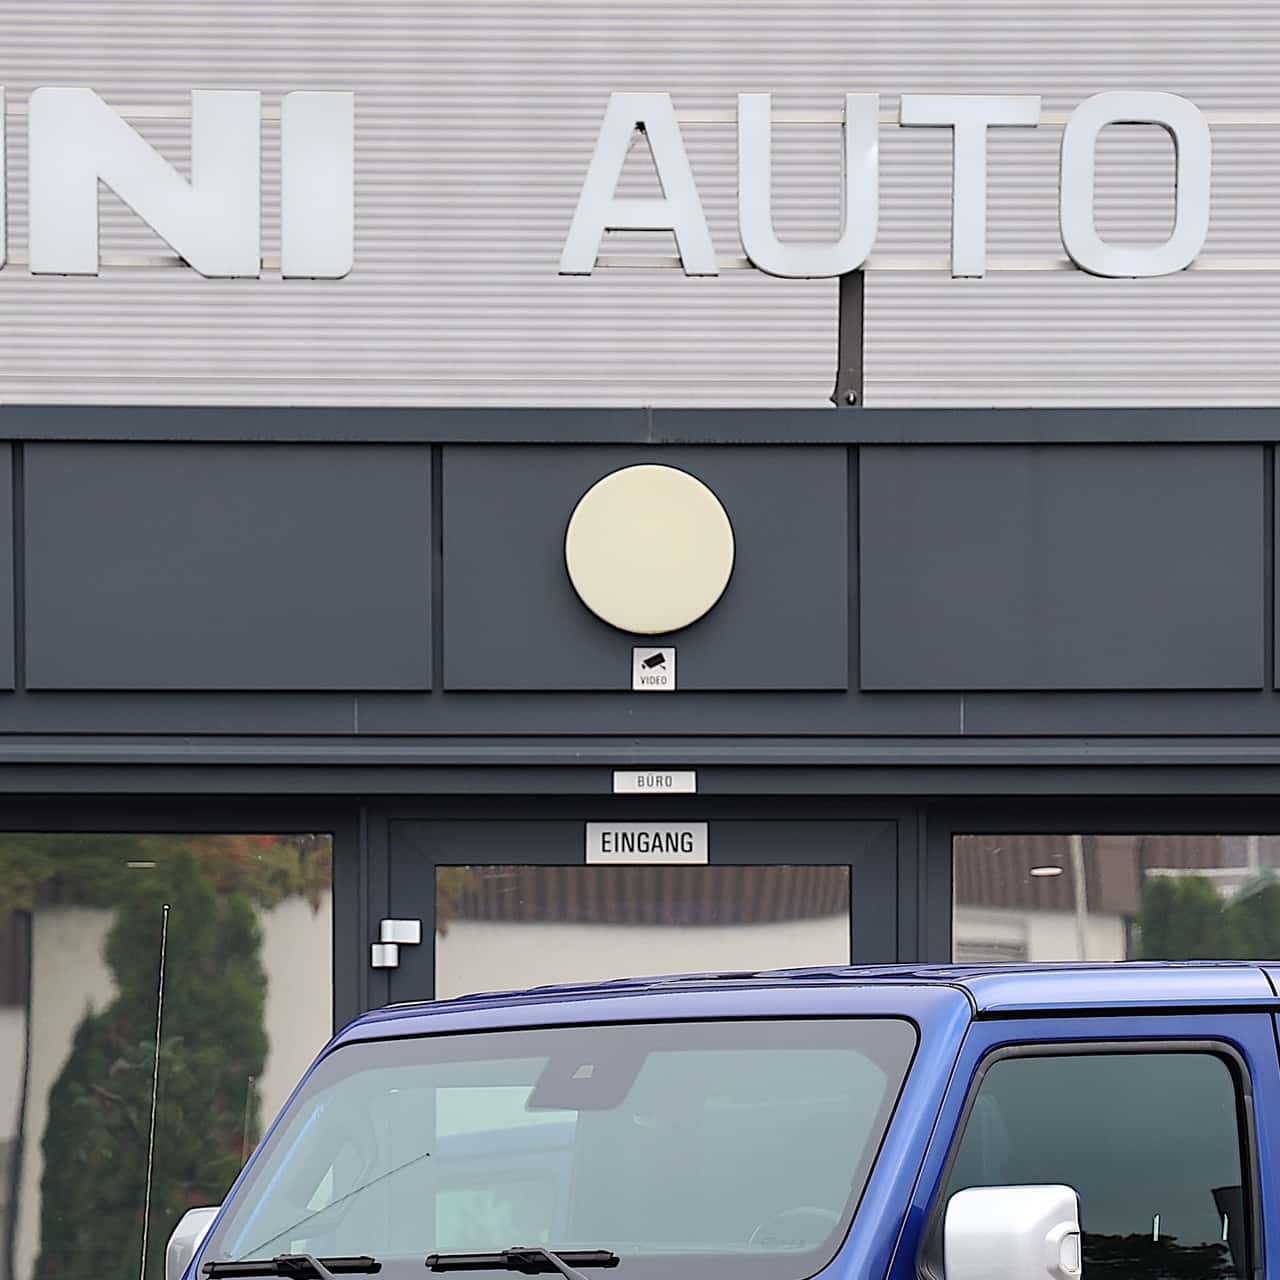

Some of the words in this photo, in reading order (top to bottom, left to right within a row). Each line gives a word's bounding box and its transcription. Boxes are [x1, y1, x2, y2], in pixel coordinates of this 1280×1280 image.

[558, 88, 1211, 278] AUTO
[639, 675, 668, 685] VIDEO
[637, 773, 673, 788] BÜRO
[601, 831, 694, 853] EINGANG
